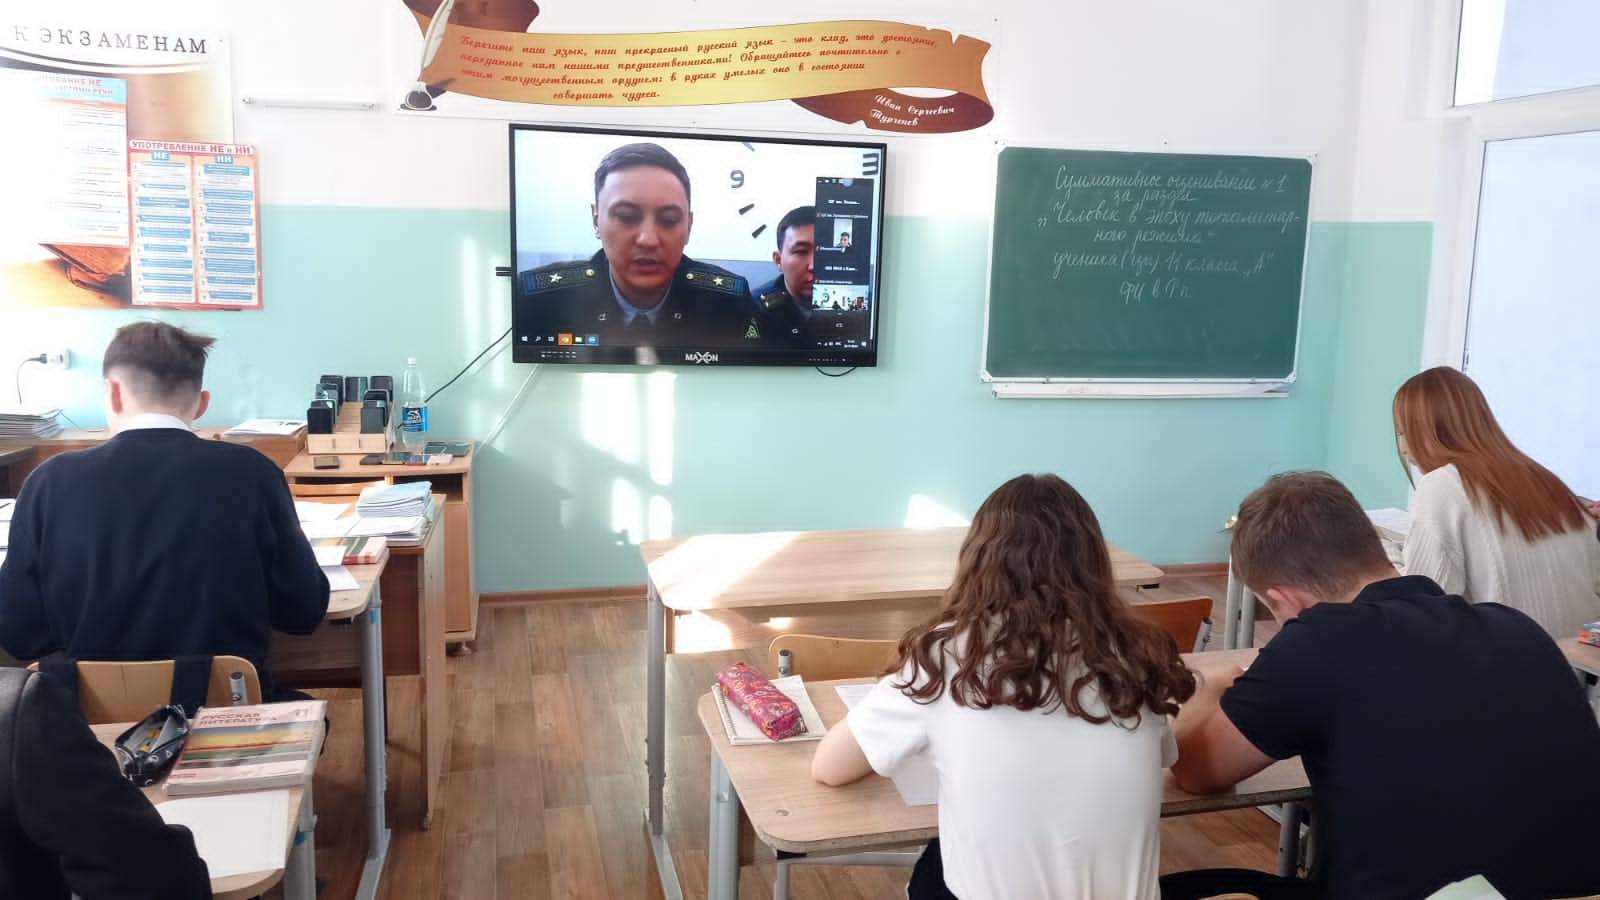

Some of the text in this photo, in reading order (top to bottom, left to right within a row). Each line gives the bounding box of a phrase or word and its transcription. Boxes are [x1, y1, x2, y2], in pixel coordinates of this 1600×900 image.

[39, 28, 208, 54] ЭКЗАМЕНАМ
[461, 36, 513, 52] Берегите
[521, 47, 546, 55] наш
[552, 48, 588, 58] язык,
[625, 44, 689, 56] прекрасный
[697, 41, 737, 53] русский
[744, 39, 774, 49] язык
[821, 35, 849, 45] клад,
[882, 34, 937, 48] достояние,
[460, 53, 523, 67] переданное
[532, 62, 556, 70] нам
[618, 54, 732, 73] предшественниками!
[740, 50, 811, 62] Обращайтесь
[819, 47, 889, 57] почтительно
[462, 68, 493, 79] этим
[501, 75, 604, 87] могущественным
[670, 72, 677, 82] в
[684, 72, 716, 84] руках
[723, 68, 766, 81] умелых
[799, 62, 805, 72] в
[811, 63, 865, 72] состоянии
[553, 90, 660, 102] совершать чудеса.
[874, 94, 955, 118] Иван Сергеевич
[870, 108, 919, 126] Тургенев
[132, 141, 208, 152] УПОТРЕБЛЕНИЕ
[209, 145, 225, 153] НЕ
[235, 146, 250, 154] НИ
[153, 151, 169, 160] НЕ
[1055, 164, 1161, 199] Суммативное
[685, 351, 719, 364] MAXON
